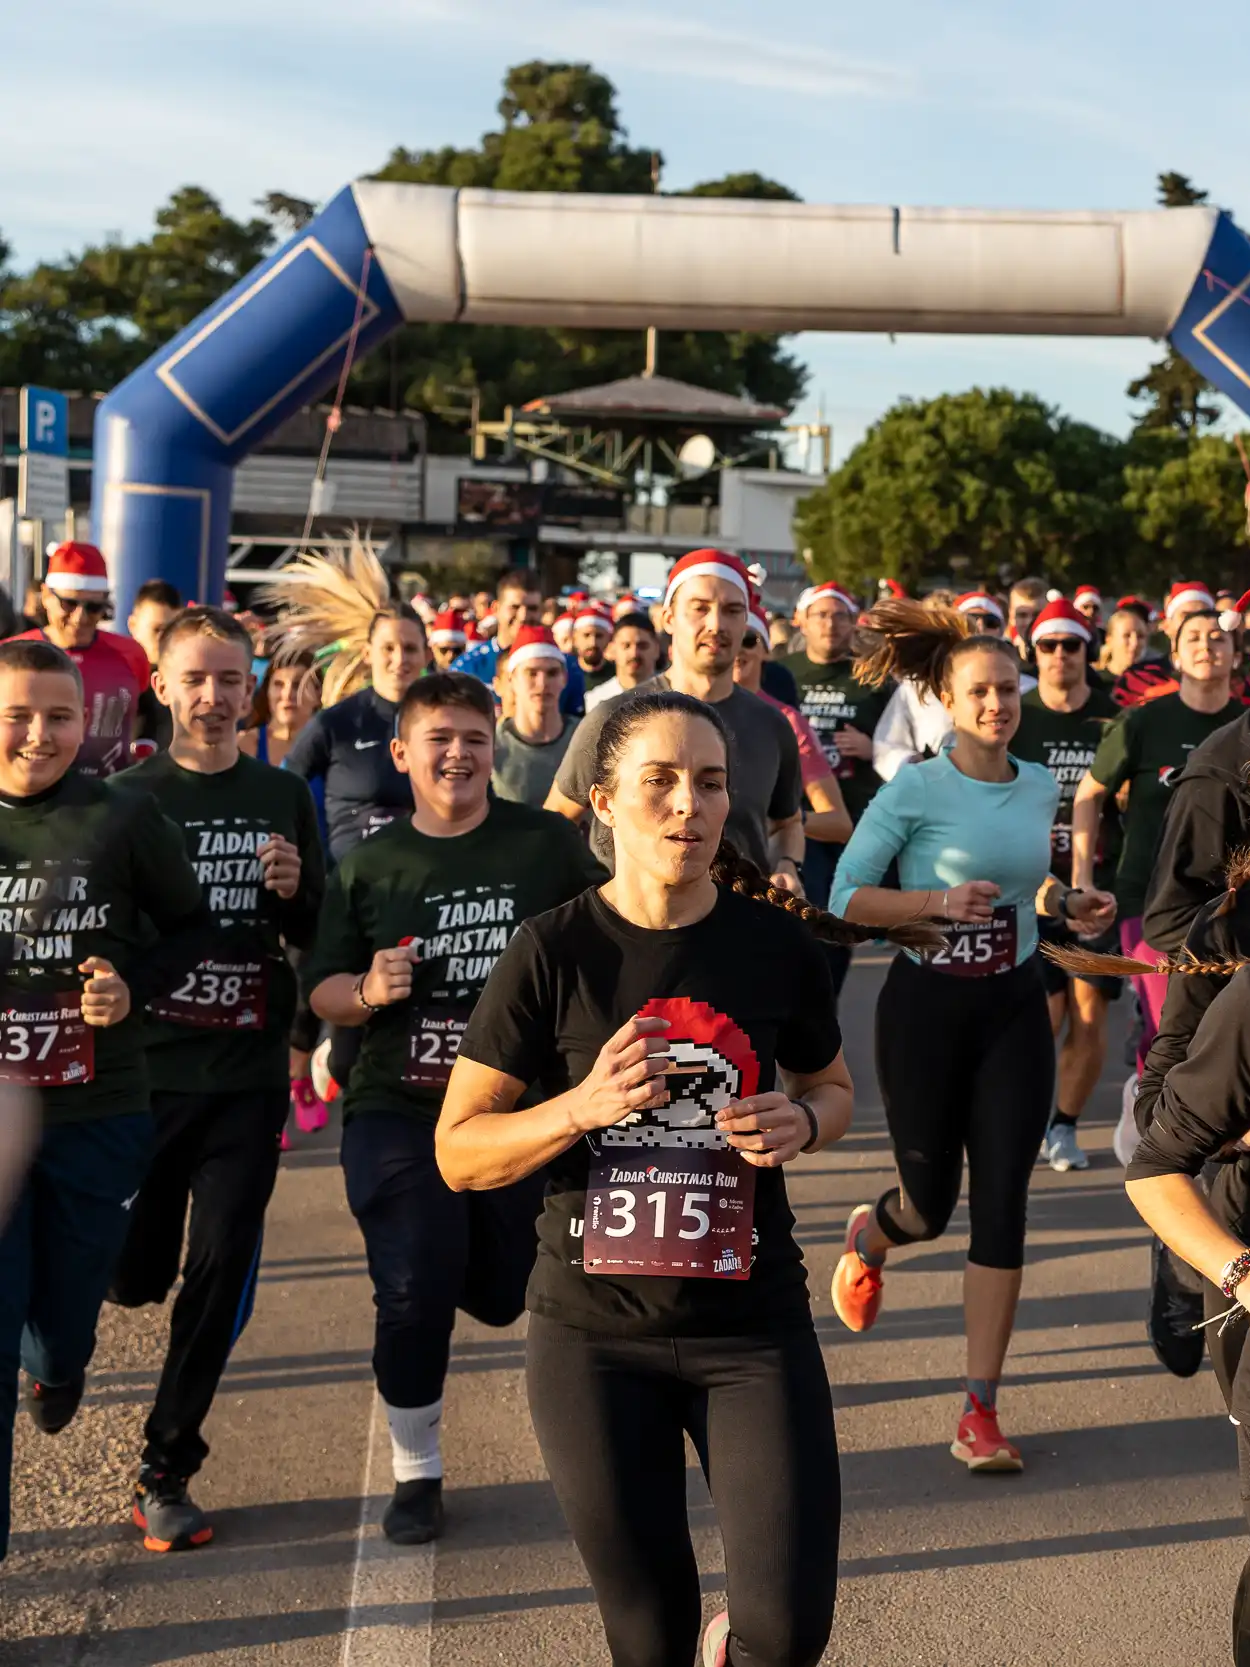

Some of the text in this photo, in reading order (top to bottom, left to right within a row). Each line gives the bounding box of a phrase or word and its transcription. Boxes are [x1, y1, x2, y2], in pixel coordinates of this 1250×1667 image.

[209, 886, 258, 912] RUN
[438, 898, 514, 930] ZADAR
[13, 933, 73, 960] RUN
[170, 971, 242, 1007] 238
[0, 1026, 59, 1062] 37
[419, 1033, 463, 1066] 23
[609, 1167, 738, 1188] ZADAR CHRISTMAS RUN
[604, 1189, 710, 1240] 315
